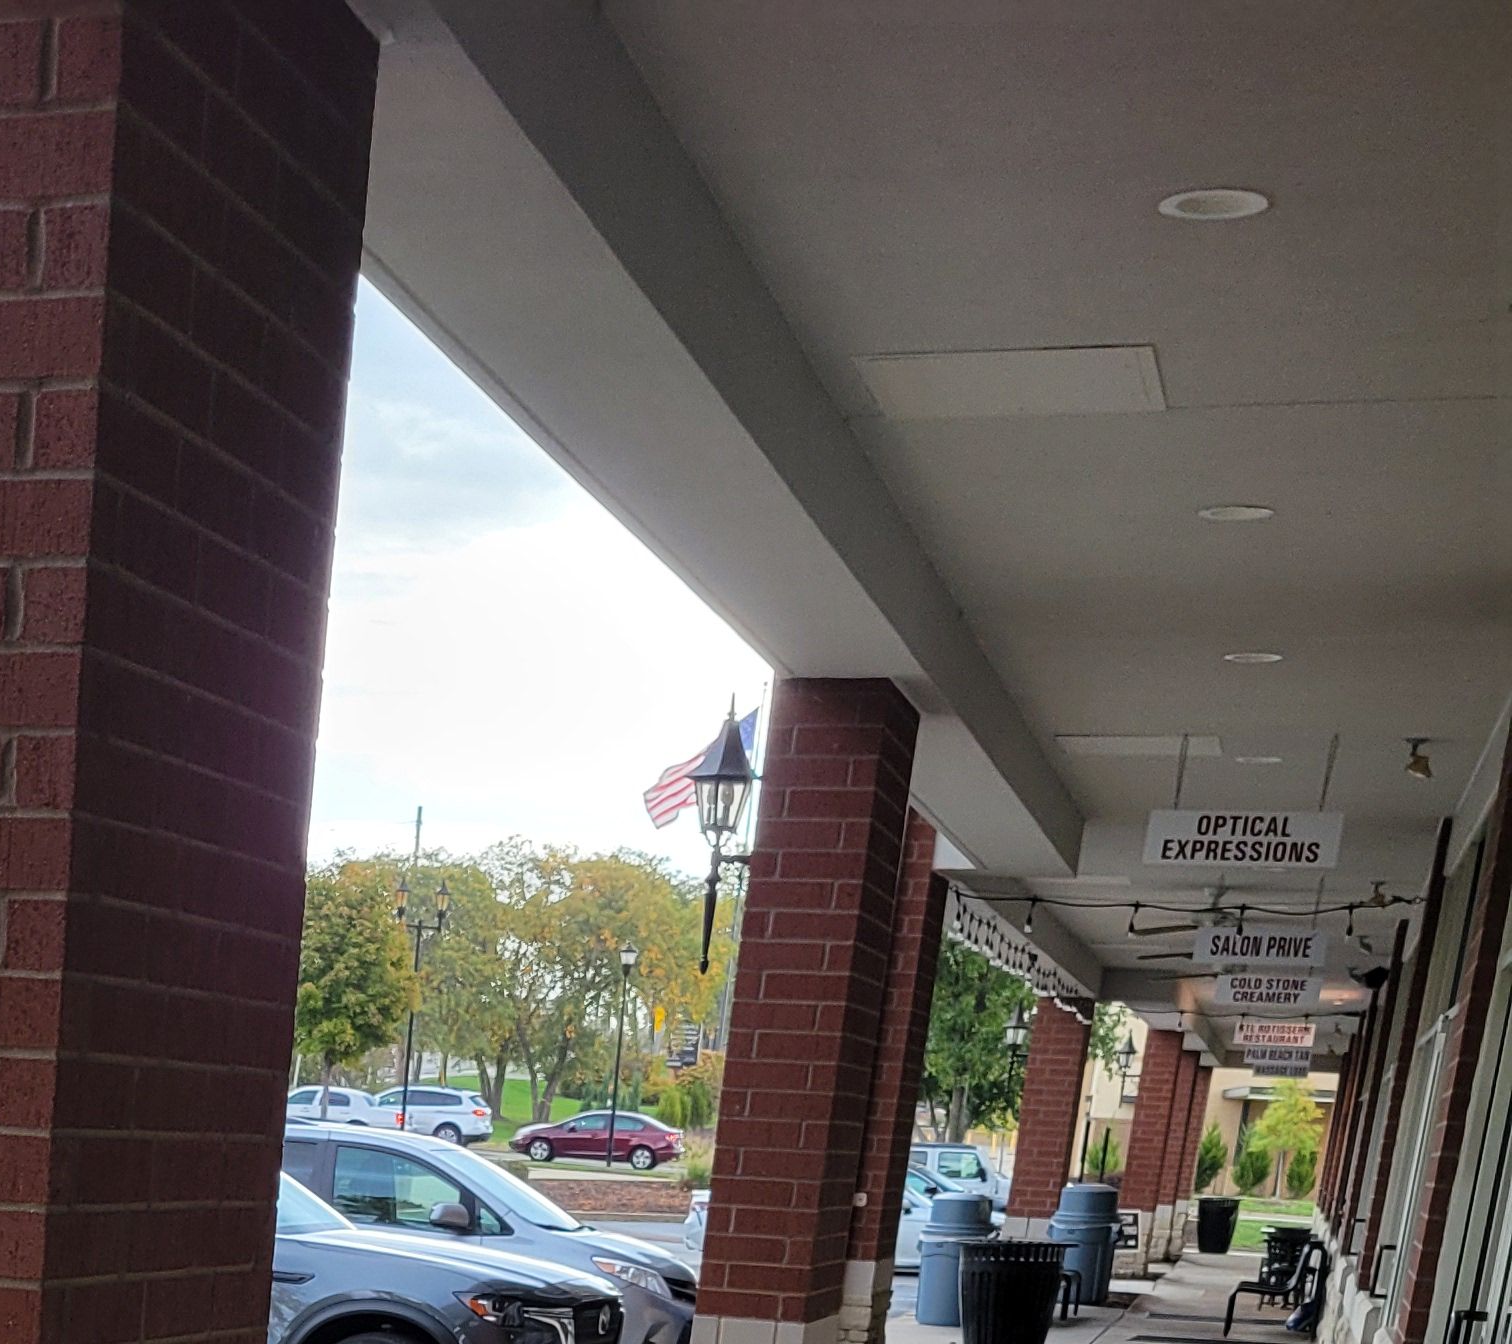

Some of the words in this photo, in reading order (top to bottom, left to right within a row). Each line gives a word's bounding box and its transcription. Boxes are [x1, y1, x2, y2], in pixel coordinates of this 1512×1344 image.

[1197, 815, 1291, 838] OPTICAL
[1161, 839, 1321, 863] EXPRESSIONS
[1210, 935, 1263, 957] SALON
[1266, 936, 1313, 958] PRIVE
[1230, 978, 1263, 990] COLD
[1266, 979, 1307, 991] STONE
[1232, 991, 1300, 1004] CREAMERY
[1243, 1034, 1305, 1044] RESTAURANT
[1246, 1048, 1267, 1060] PALM
[1268, 1049, 1293, 1061] BEACH
[1295, 1050, 1311, 1062] TAN
